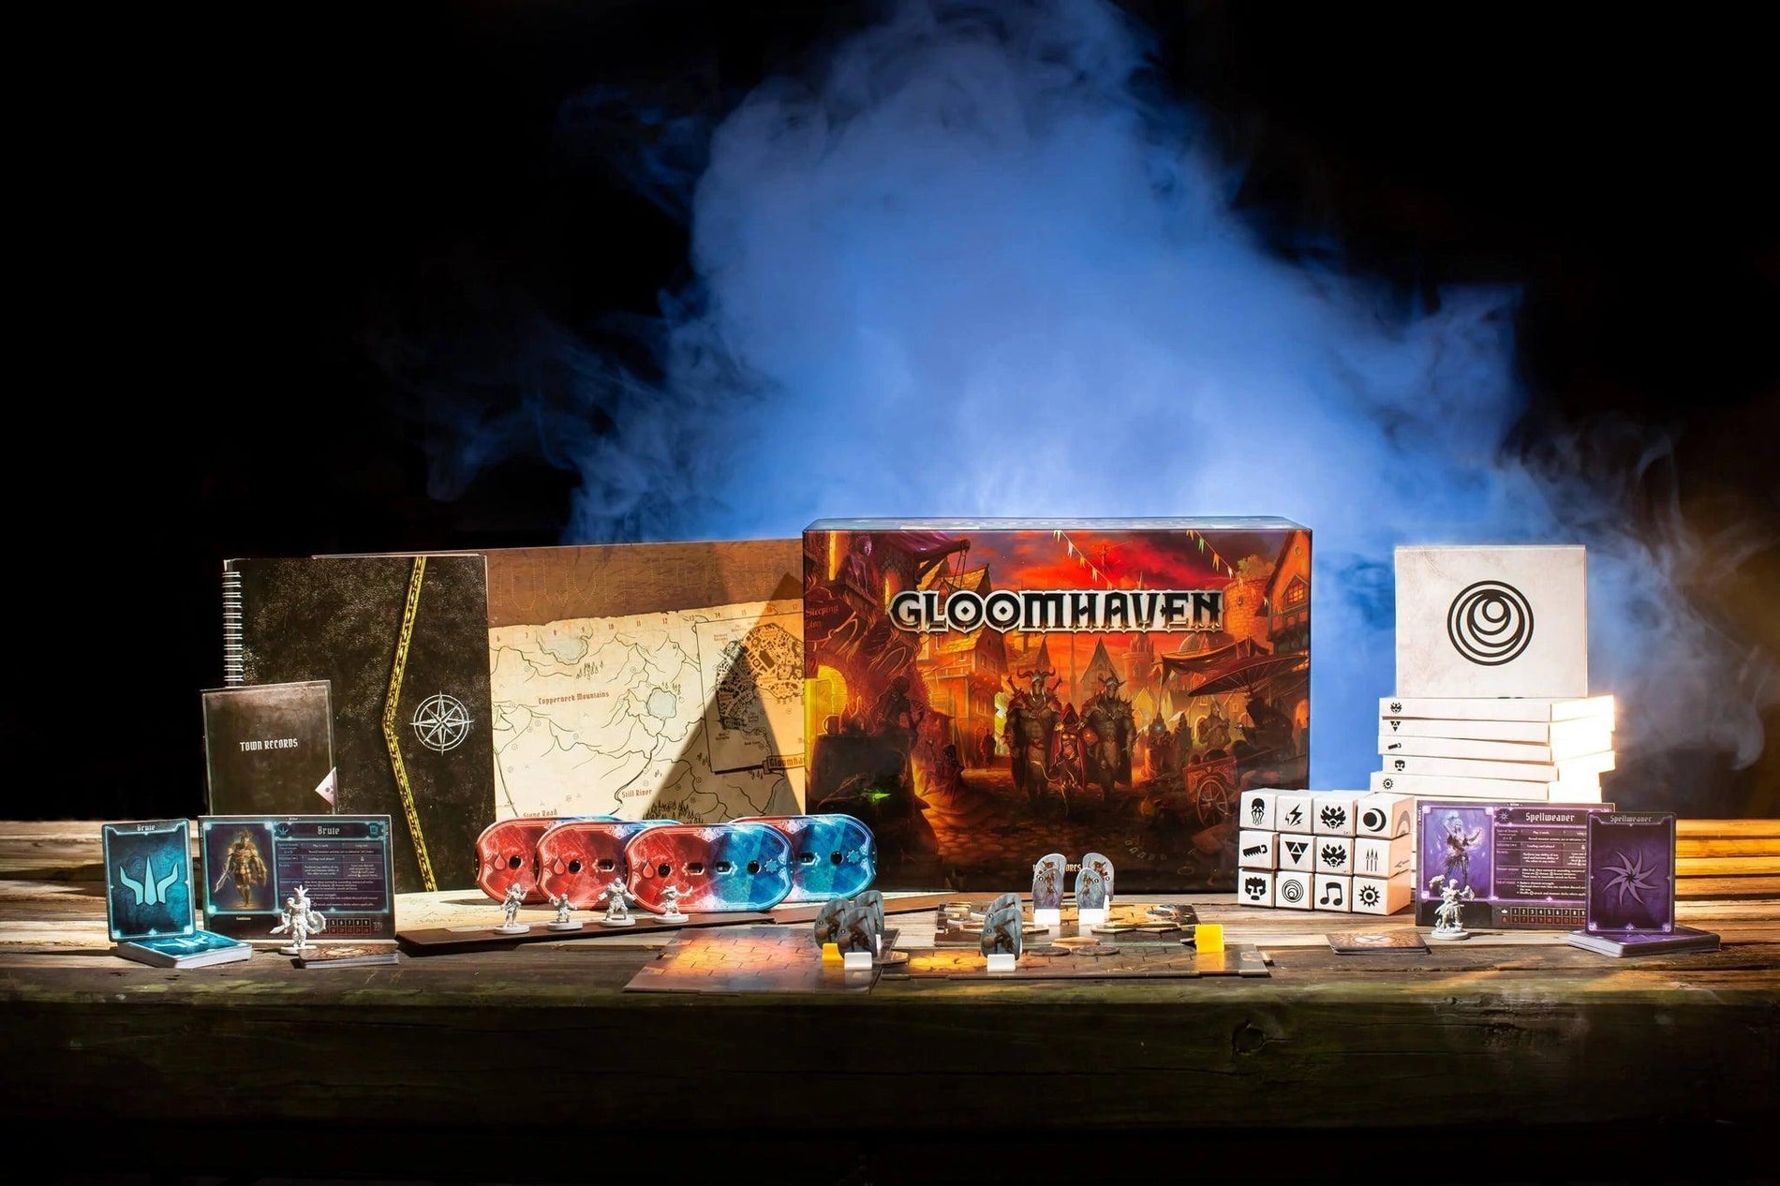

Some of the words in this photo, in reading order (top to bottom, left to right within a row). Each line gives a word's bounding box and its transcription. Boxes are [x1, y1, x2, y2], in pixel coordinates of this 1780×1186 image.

[888, 589, 1224, 633] GLOOMHAVEN
[576, 691, 610, 700] Mountains
[240, 740, 263, 752] TOWN
[264, 738, 299, 750] RECORDS
[635, 789, 652, 797] River
[1525, 812, 1575, 823] Spellweaver
[1610, 814, 1652, 824] Spellweaver
[136, 824, 156, 832] Brute
[317, 825, 340, 835] Brute
